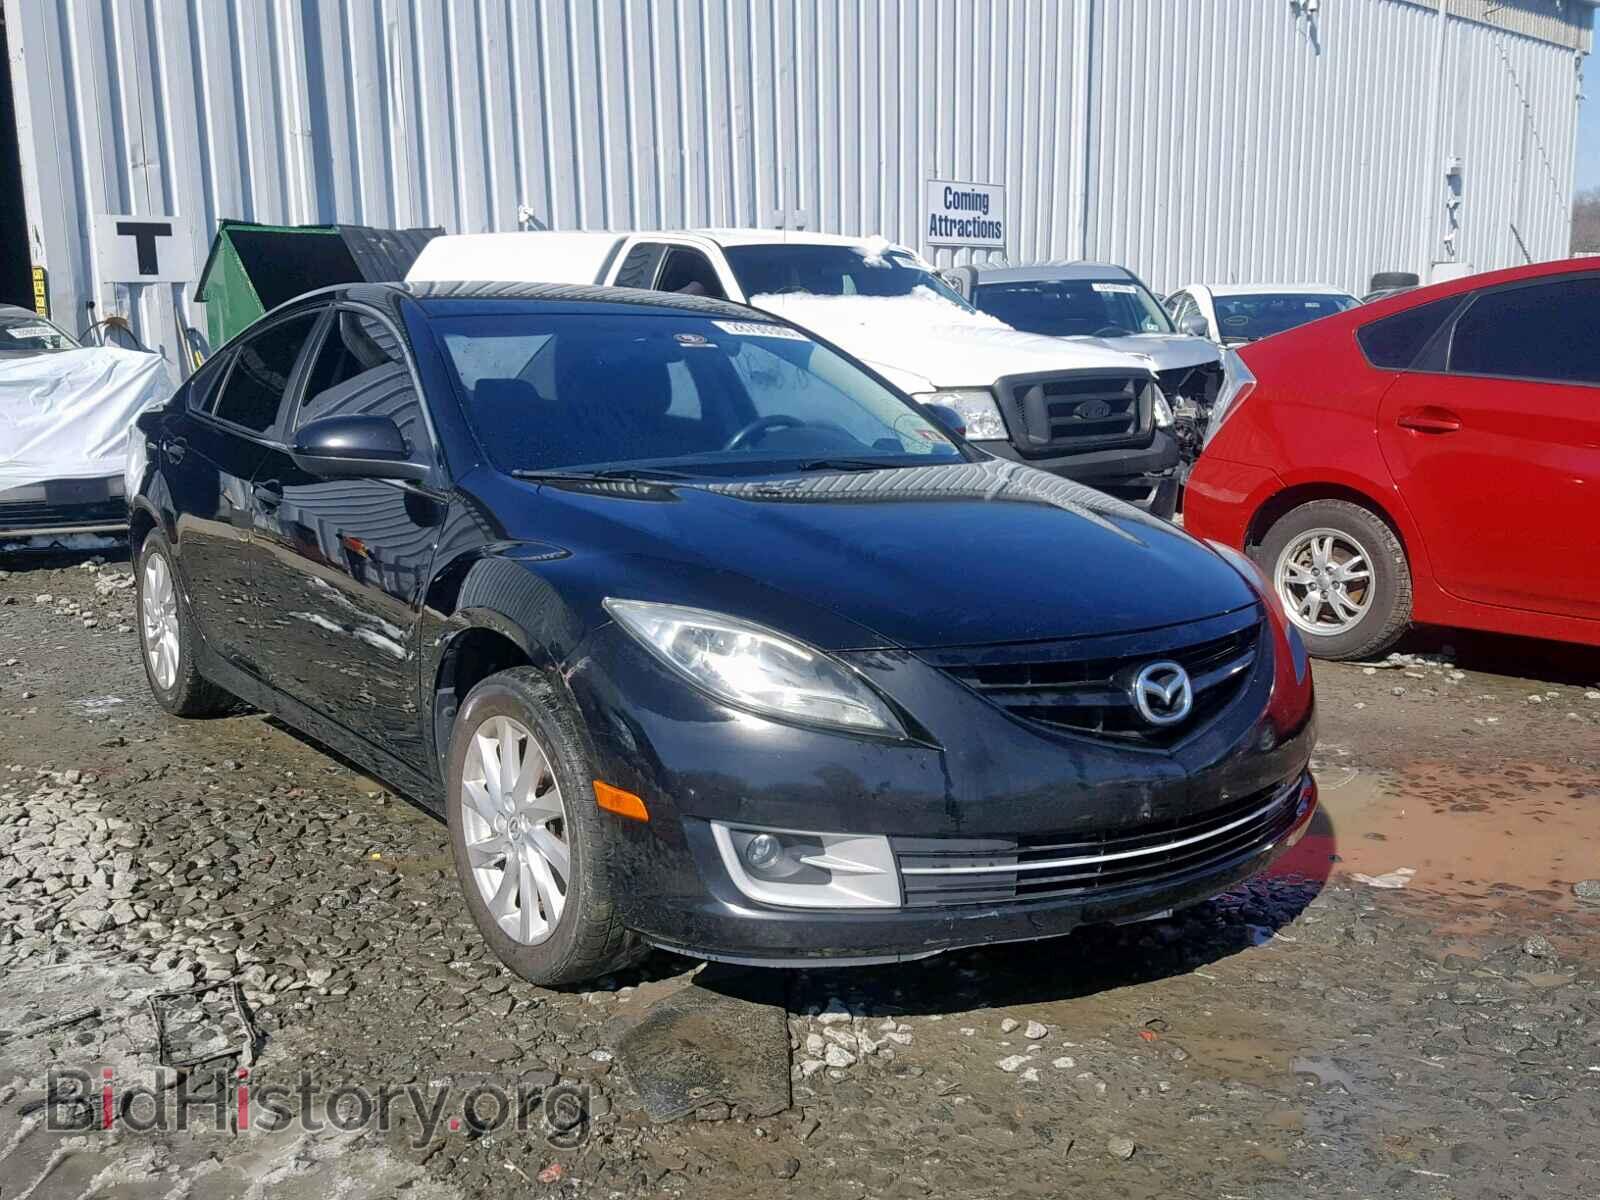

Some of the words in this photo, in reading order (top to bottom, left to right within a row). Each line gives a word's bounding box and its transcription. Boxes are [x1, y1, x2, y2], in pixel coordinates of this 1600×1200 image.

[944, 186, 990, 215] Coming
[928, 213, 1003, 239] Attractions
[116, 222, 173, 275] T
